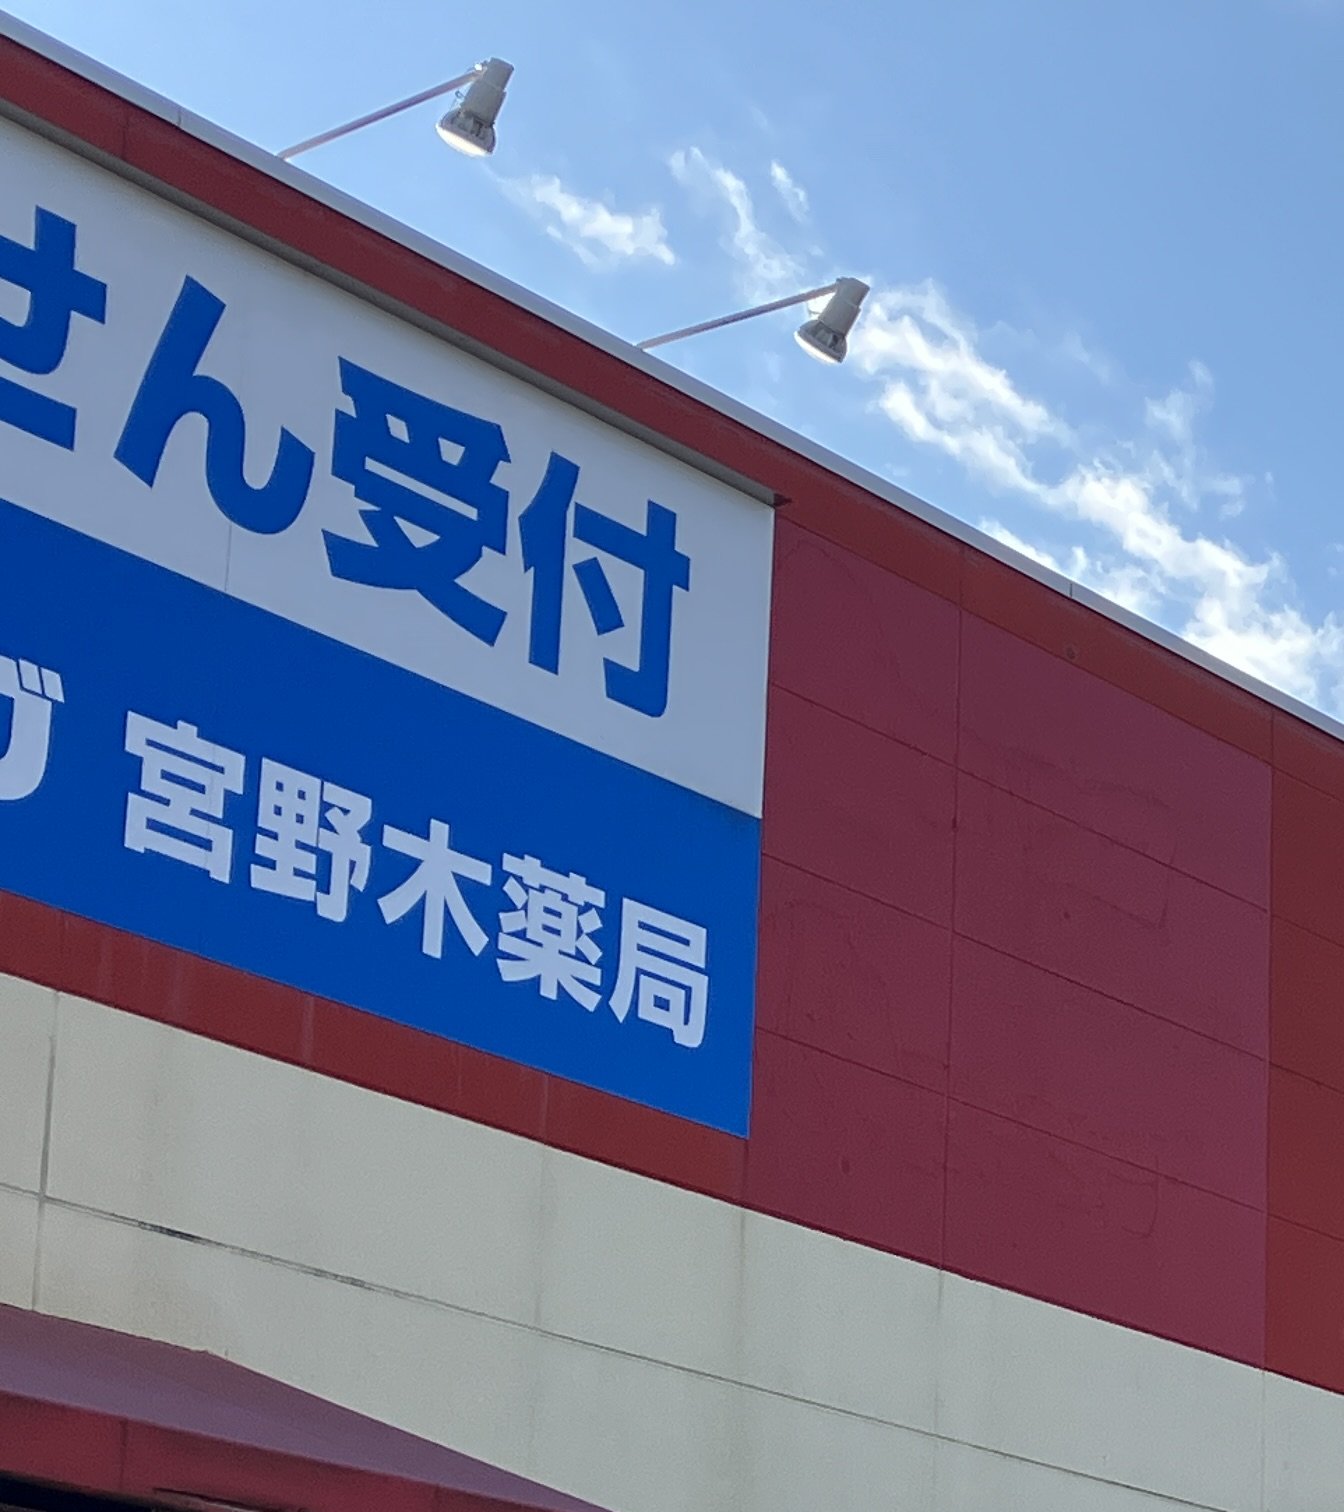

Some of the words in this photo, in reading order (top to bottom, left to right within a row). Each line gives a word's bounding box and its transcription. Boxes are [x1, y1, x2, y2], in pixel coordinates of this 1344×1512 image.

[123, 710, 709, 1048] 宮野木薬局
